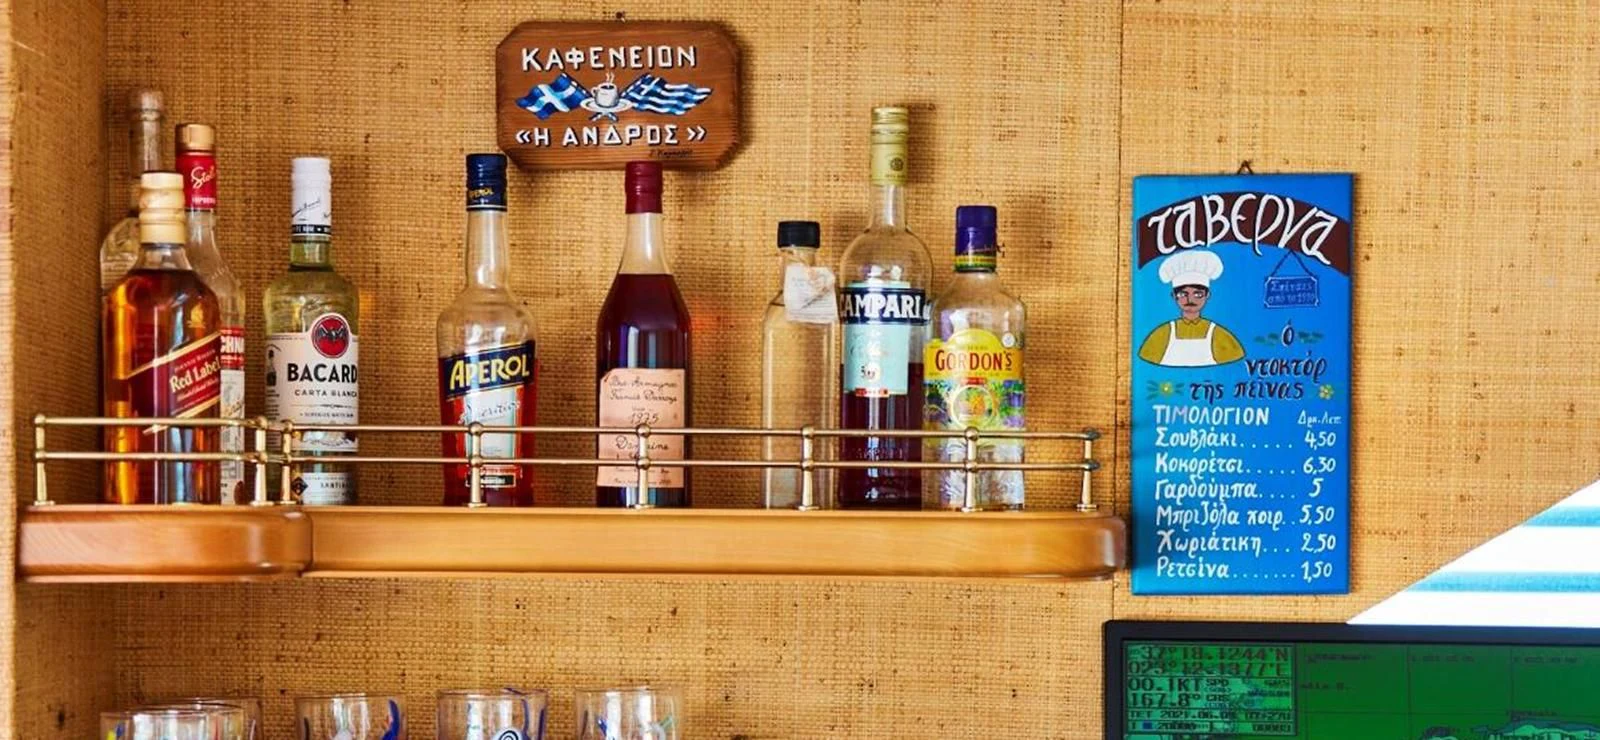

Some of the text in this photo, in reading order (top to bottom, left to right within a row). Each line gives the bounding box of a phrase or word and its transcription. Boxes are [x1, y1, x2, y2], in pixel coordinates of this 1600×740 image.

[521, 45, 697, 72] ΚΑΦΕΝΕΙΟΝ
[169, 369, 194, 393] Red
[192, 356, 222, 382] Label
[450, 353, 530, 391] APEROL
[294, 389, 327, 397] CARTA
[1152, 404, 1270, 426] ΤΙΜΟΛΟΓΙΟΝ
[1304, 430, 1337, 451] 4,50
[1302, 456, 1336, 475] 6,30
[1308, 477, 1324, 498] 5
[1299, 503, 1336, 525] 5,50
[1299, 532, 1337, 554] 2,50
[1300, 560, 1334, 583] 1,50
